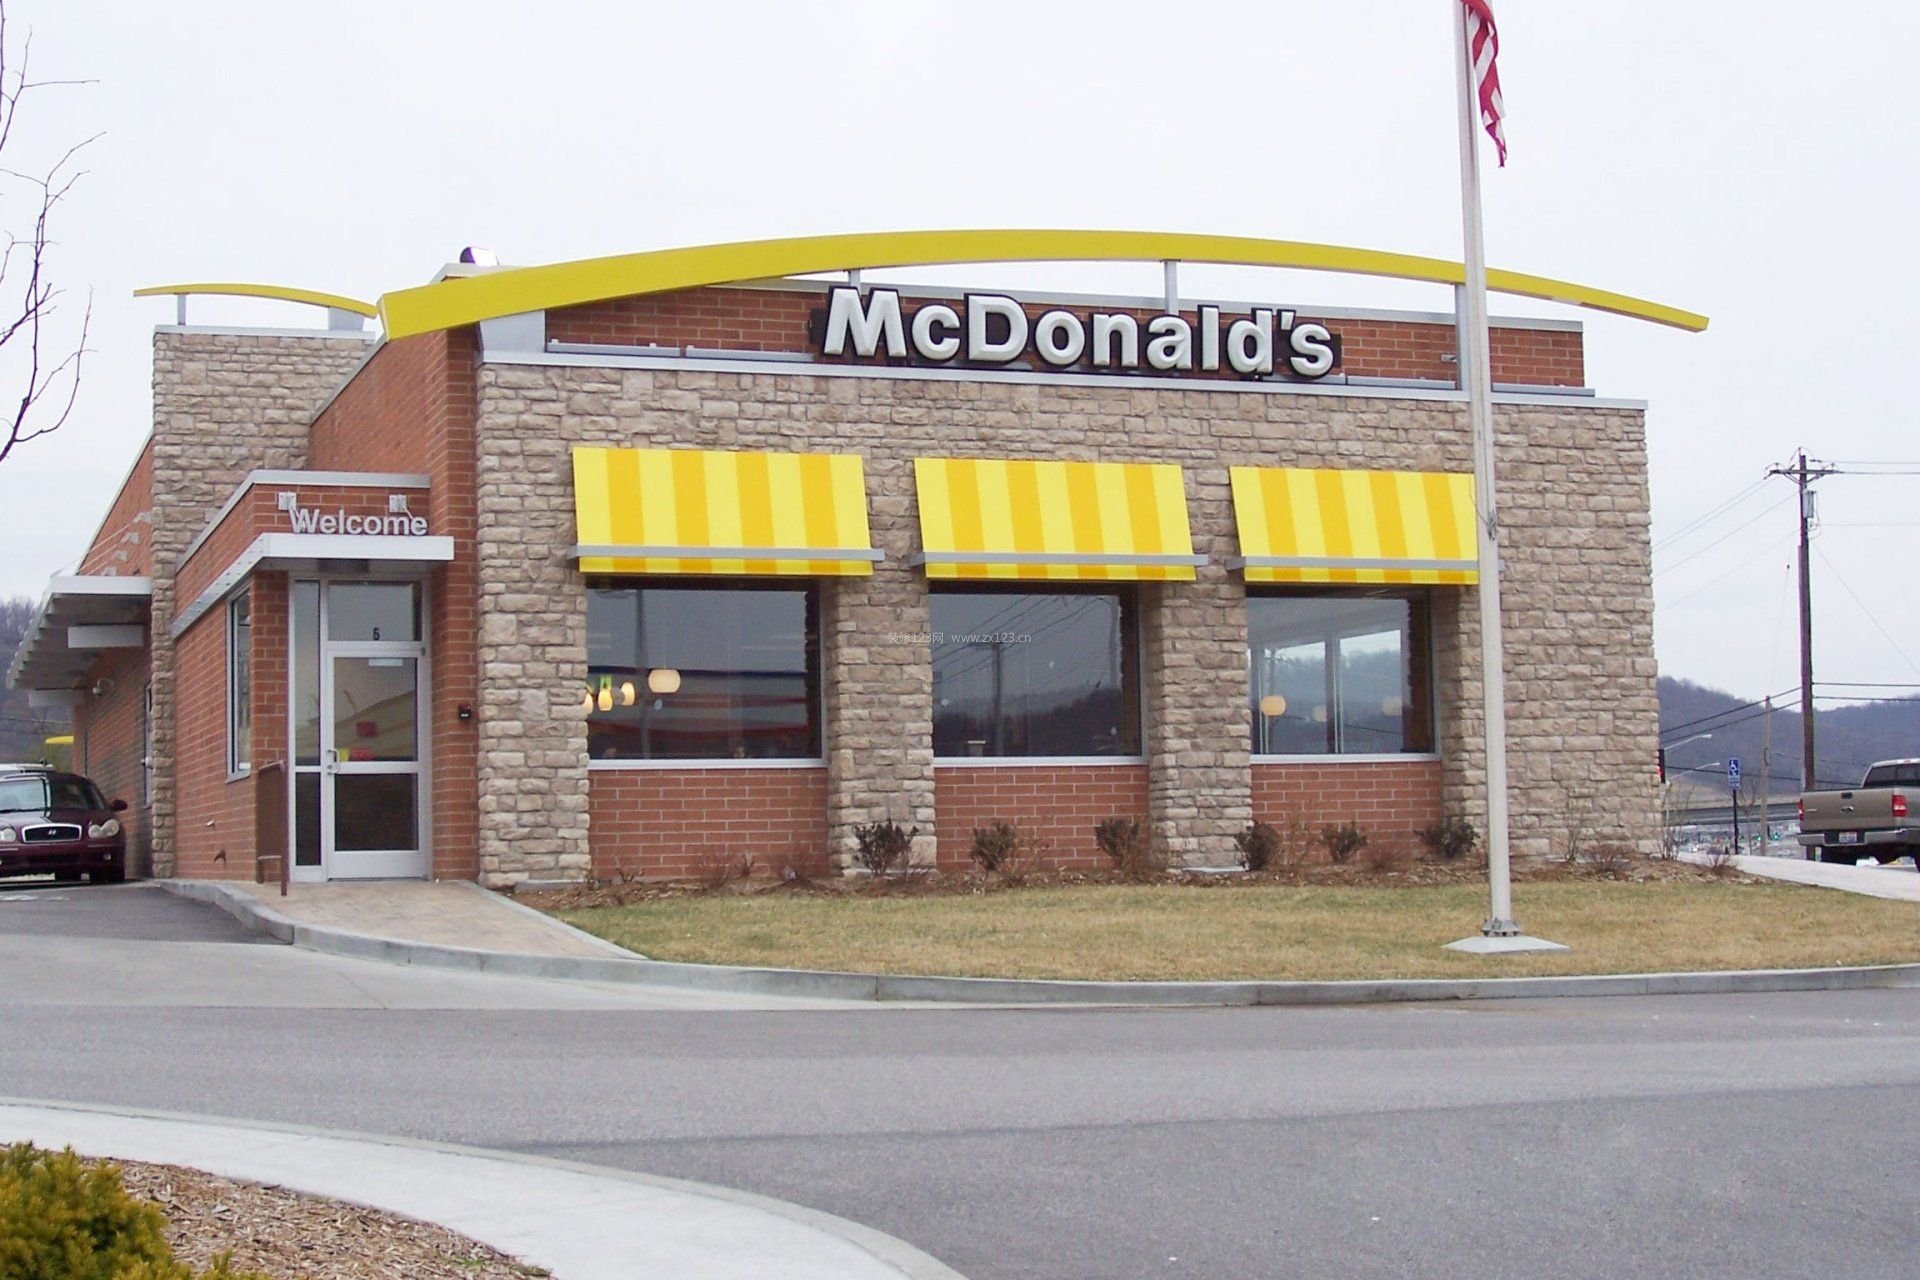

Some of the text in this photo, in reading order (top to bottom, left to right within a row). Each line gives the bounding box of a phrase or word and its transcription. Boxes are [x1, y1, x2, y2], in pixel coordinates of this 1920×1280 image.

[822, 286, 1334, 377] McDonald's
[288, 508, 428, 536] Welcome
[373, 627, 380, 641] 6
